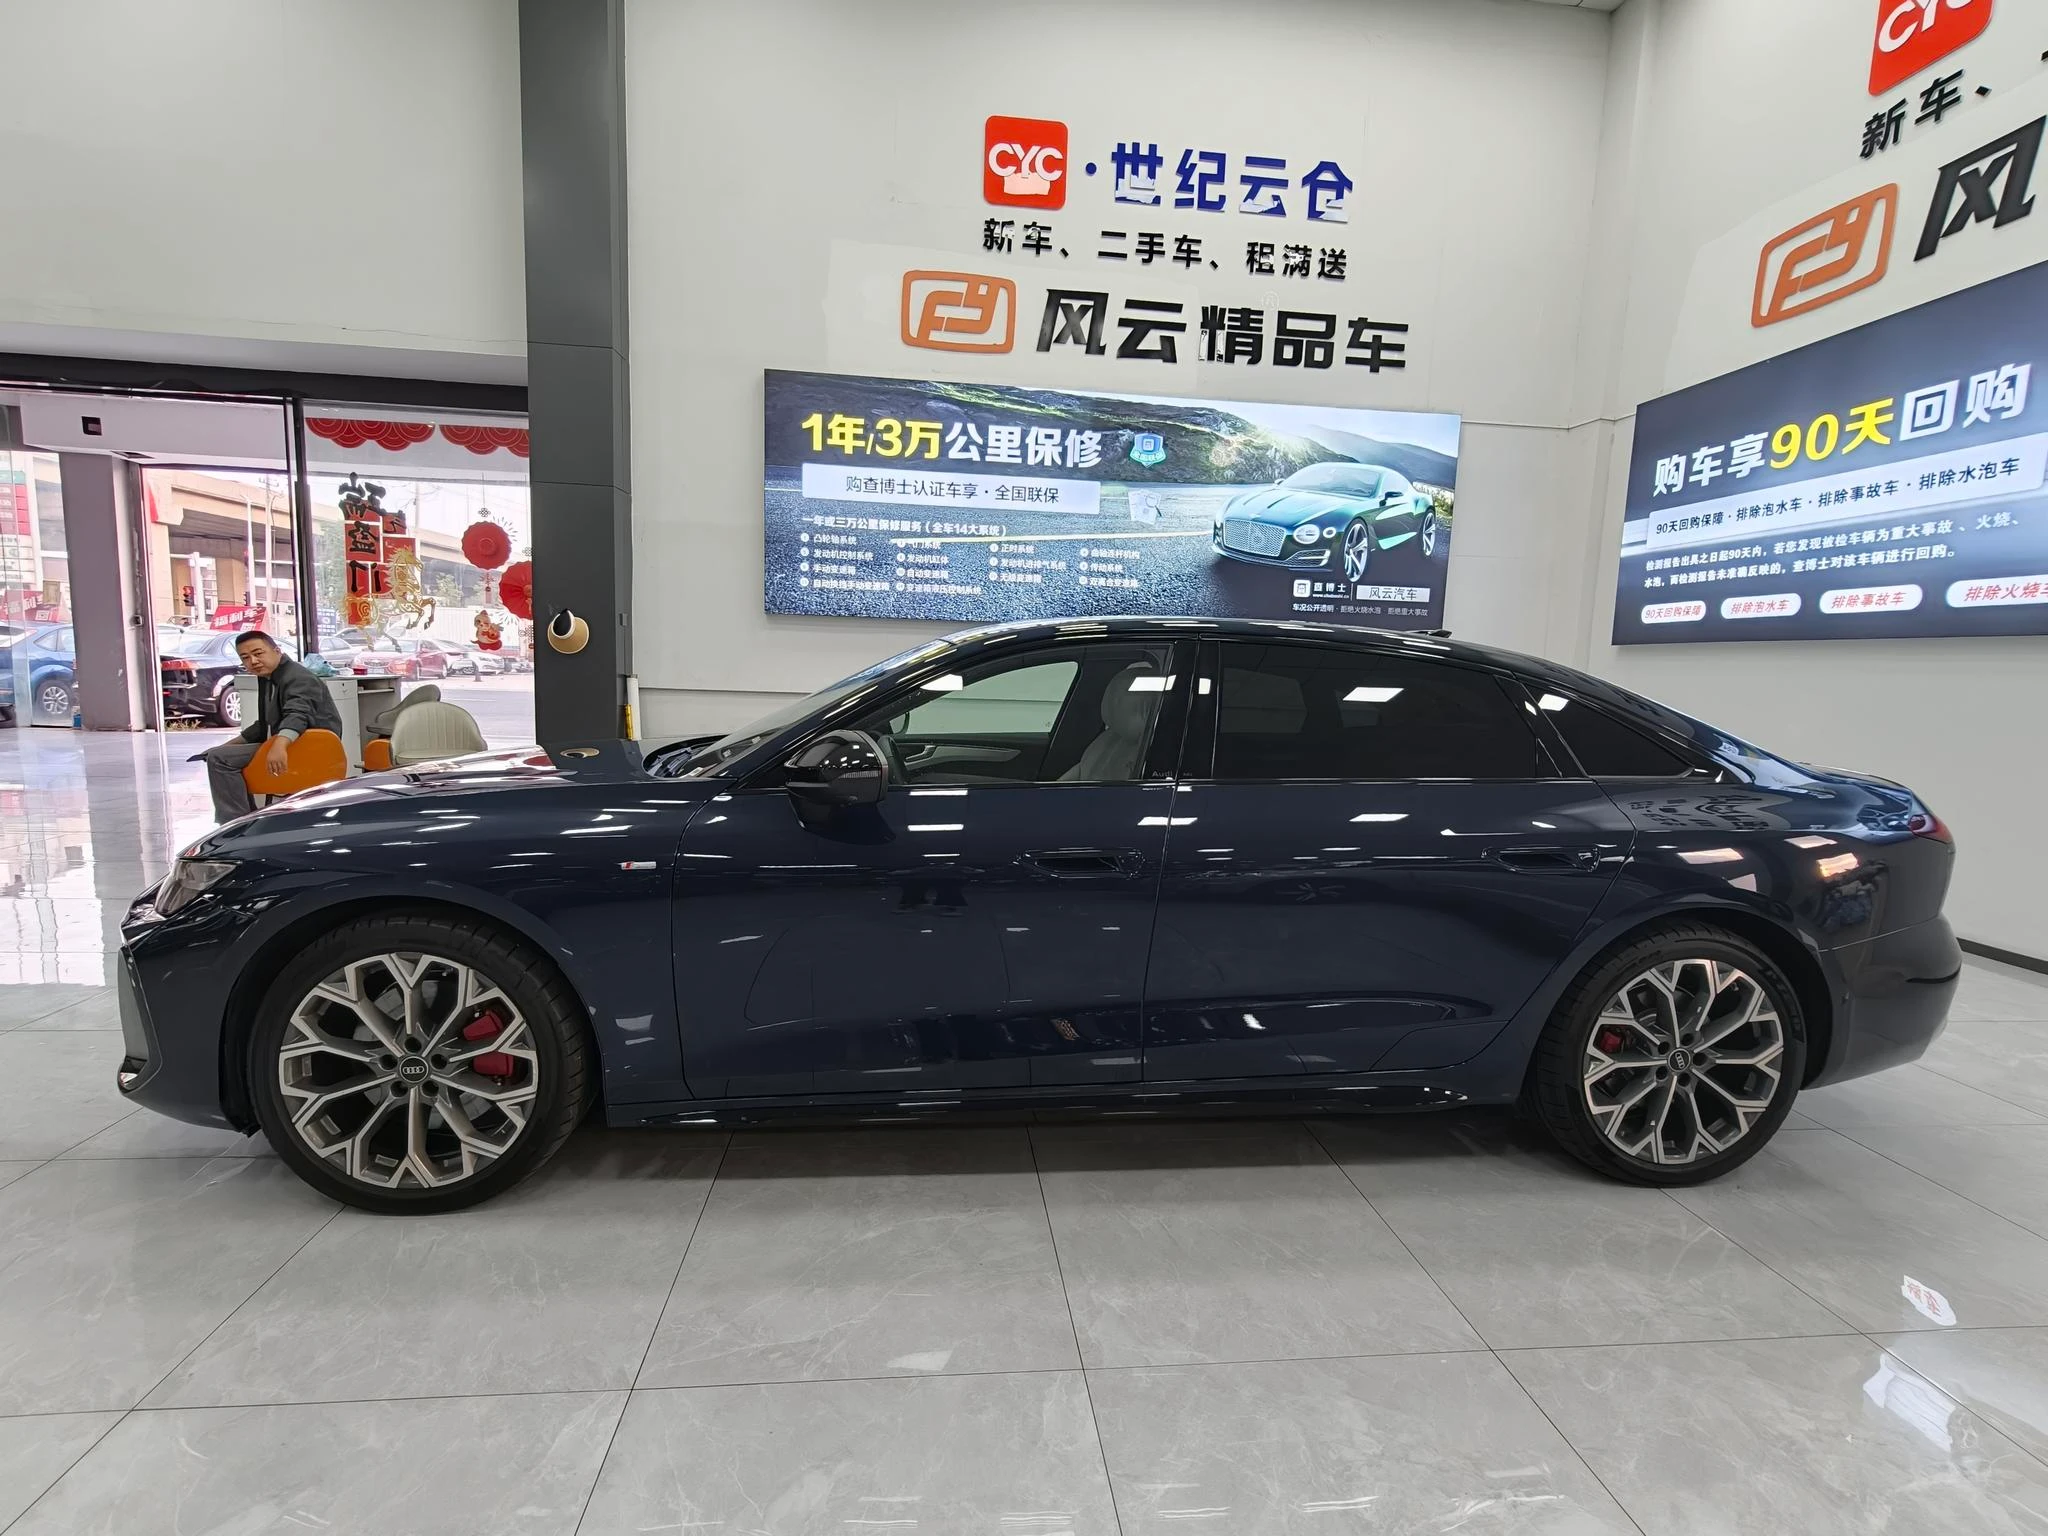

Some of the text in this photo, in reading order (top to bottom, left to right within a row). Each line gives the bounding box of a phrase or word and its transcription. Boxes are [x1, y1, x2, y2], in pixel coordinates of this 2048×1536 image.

[1878, 0, 1973, 52] CY
[988, 142, 1064, 181] CYC
[1913, 114, 2047, 262] 风
[1036, 288, 1410, 374] 风云精品车
[1653, 362, 2031, 497] 购车享90天回购
[1369, 587, 1418, 600] 风云汽车
